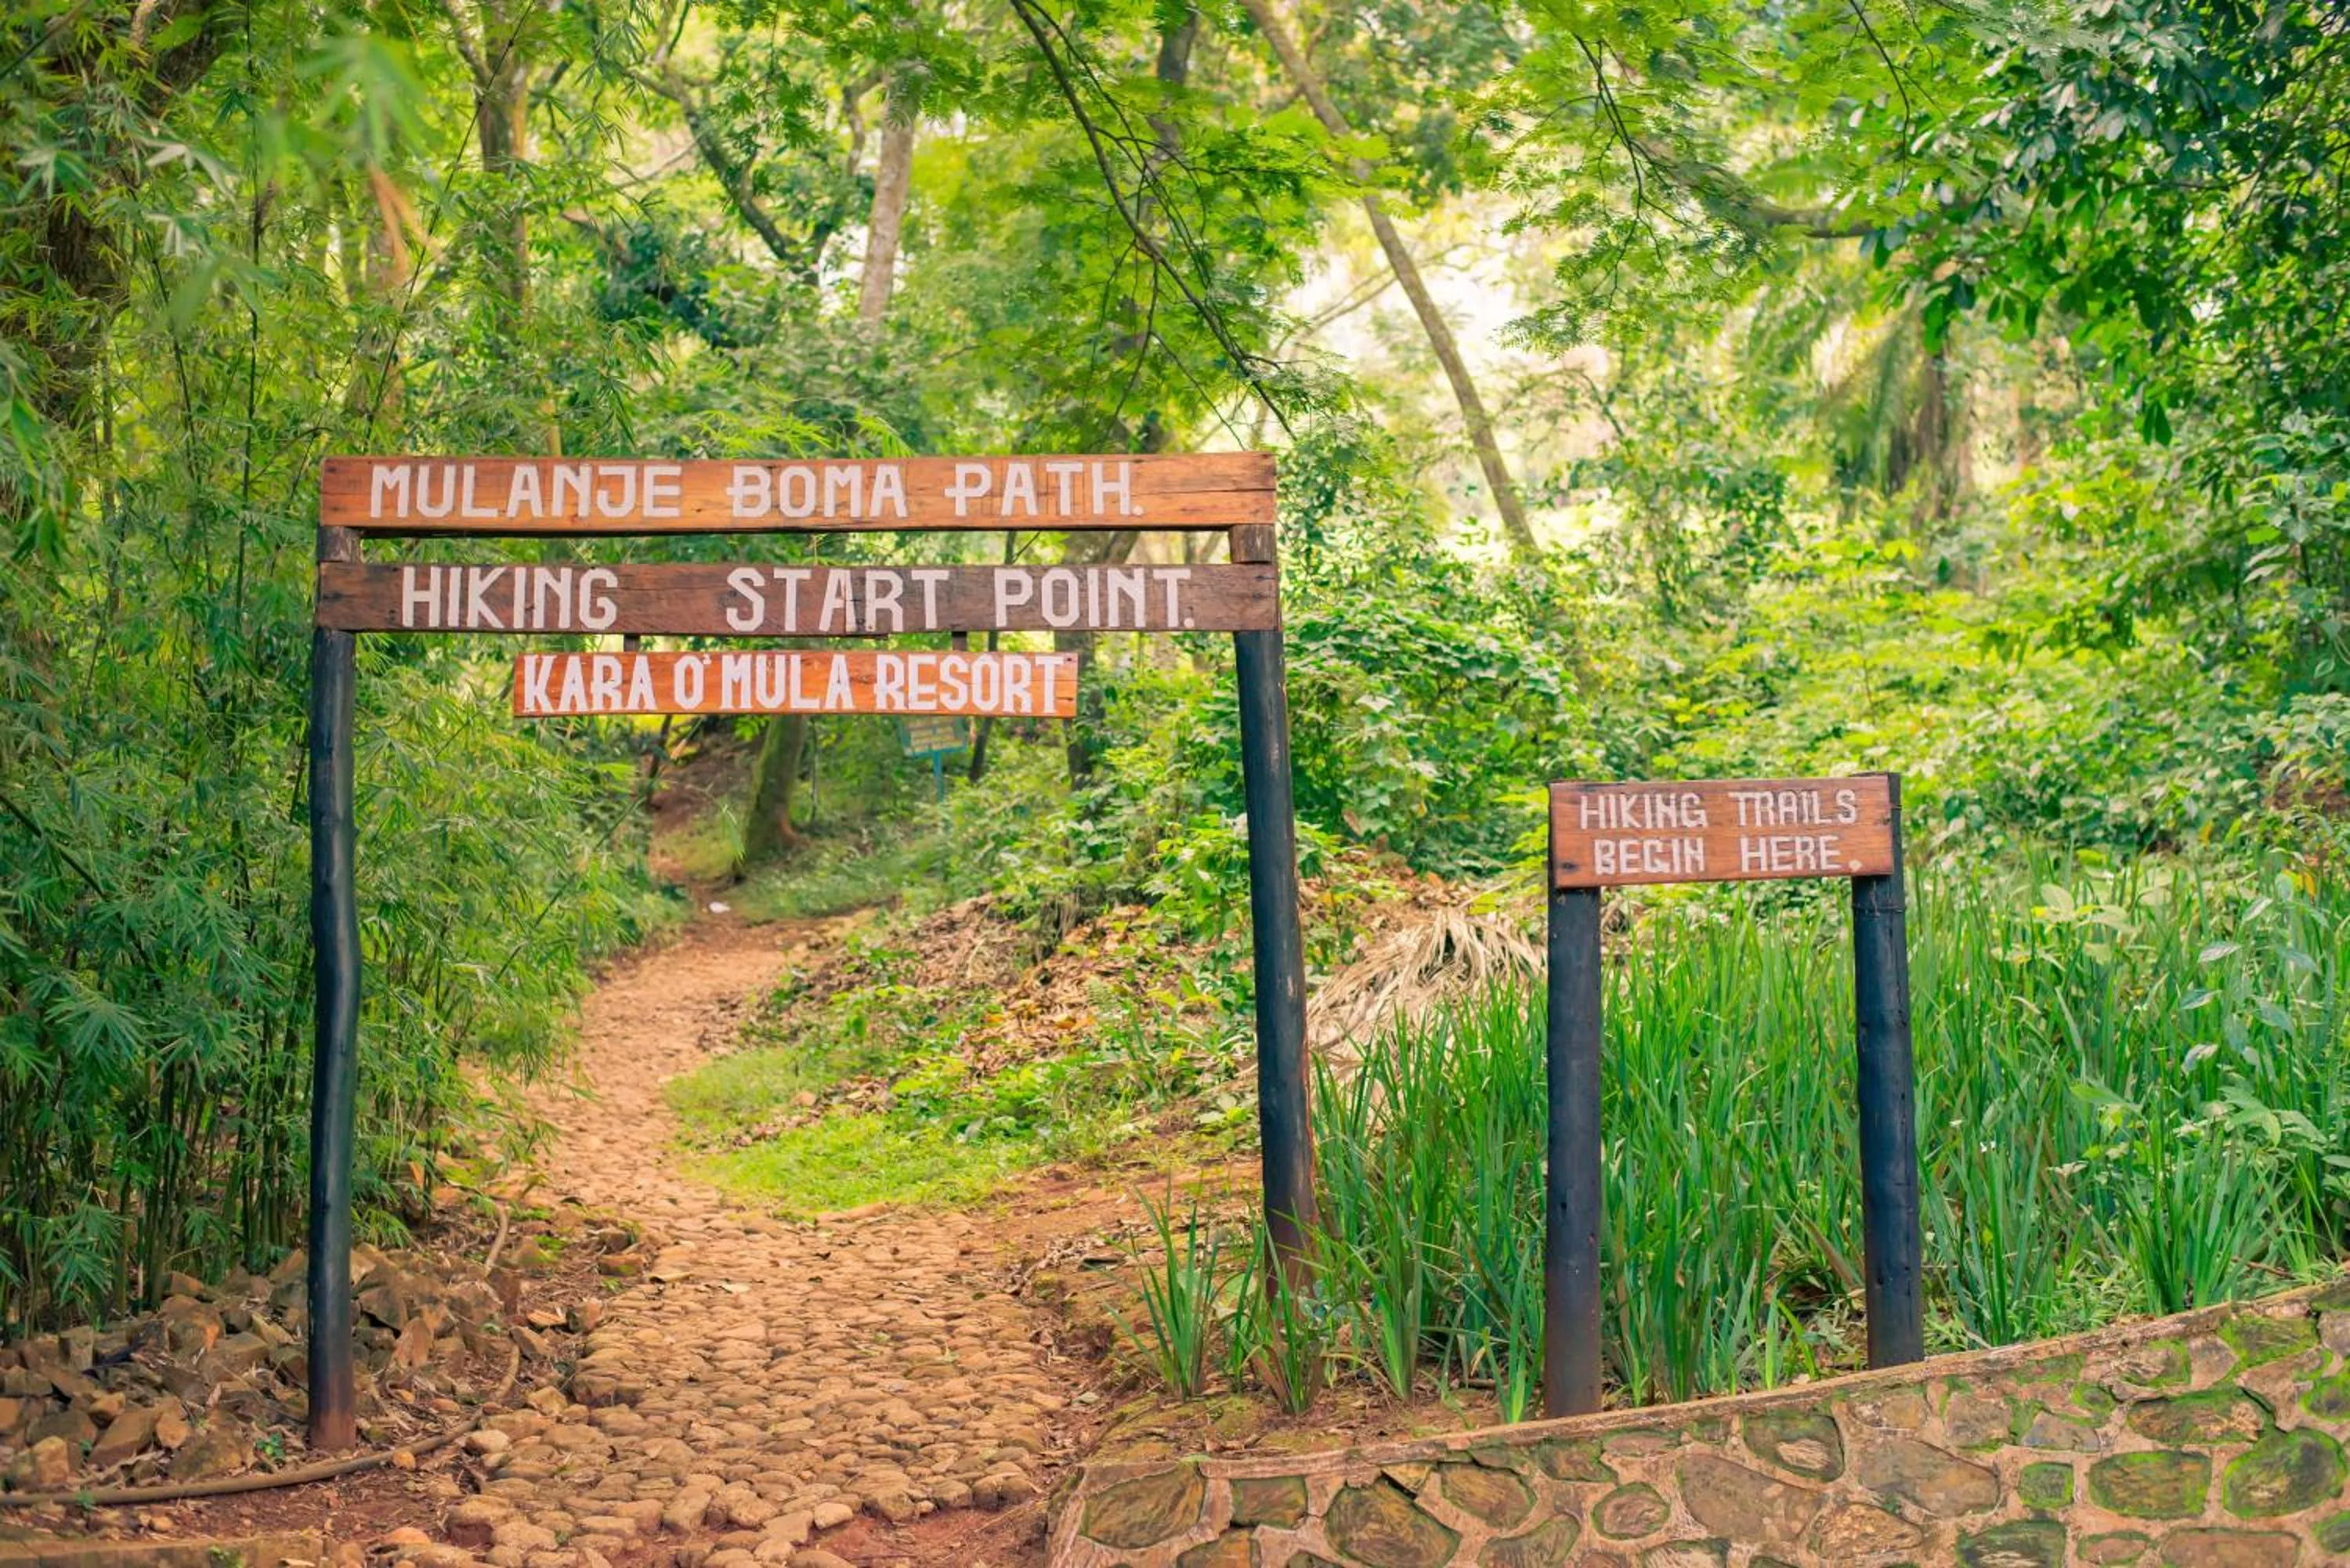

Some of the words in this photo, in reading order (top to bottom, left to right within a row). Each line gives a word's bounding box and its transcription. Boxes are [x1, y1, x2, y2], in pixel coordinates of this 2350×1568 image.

[370, 464, 682, 518] MULANJE
[726, 464, 908, 517] BOMA
[945, 461, 1144, 516] PATH.
[401, 566, 619, 630] HIKING
[725, 568, 949, 632] START
[994, 567, 1195, 629] POINT.
[522, 654, 656, 713] KARA
[874, 653, 1065, 714] RESORT
[1579, 793, 1708, 830] HIKING
[1593, 837, 1705, 876] BEGIN
[1740, 835, 1864, 873] HERE.
